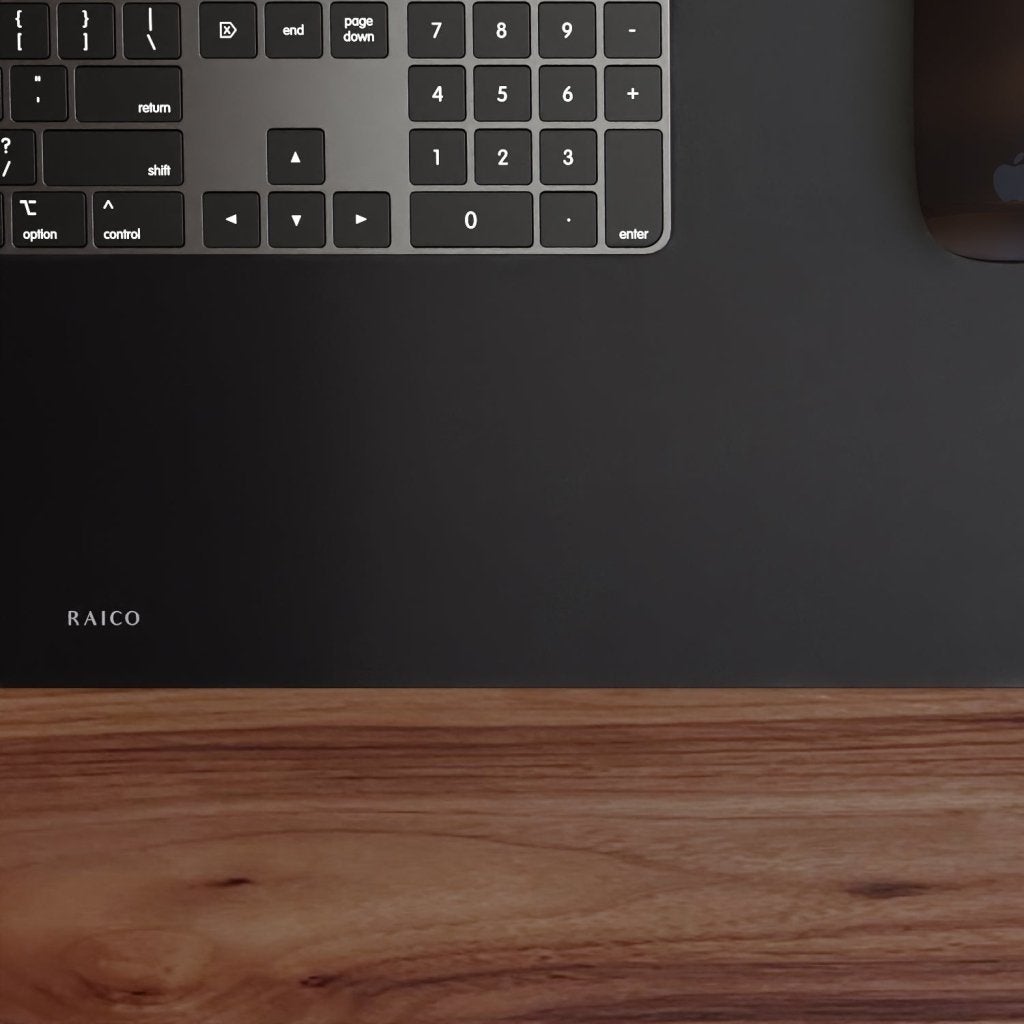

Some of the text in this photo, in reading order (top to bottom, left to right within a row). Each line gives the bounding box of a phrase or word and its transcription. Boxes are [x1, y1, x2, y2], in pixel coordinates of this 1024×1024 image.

[14, 9, 23, 29] {
[81, 9, 90, 29] }
[344, 17, 374, 30] page
[282, 23, 305, 36] end
[342, 30, 375, 43] down
[430, 21, 443, 39] 7
[495, 21, 508, 39] 8
[561, 21, 573, 39] 9
[16, 32, 23, 52] [
[82, 32, 89, 52] ]
[431, 85, 444, 103] 4
[496, 85, 508, 103] 5
[562, 85, 574, 103] 6
[626, 87, 640, 100] +
[137, 101, 172, 114] return
[0, 136, 12, 155] ?
[432, 148, 440, 166] 1
[497, 148, 509, 166] 2
[562, 148, 574, 166] 3
[1, 160, 12, 178] /
[147, 163, 172, 177] shift
[464, 210, 478, 230] 0
[22, 228, 58, 242] option
[103, 227, 141, 240] control
[618, 228, 650, 240] enter
[67, 610, 140, 627] RAICO
